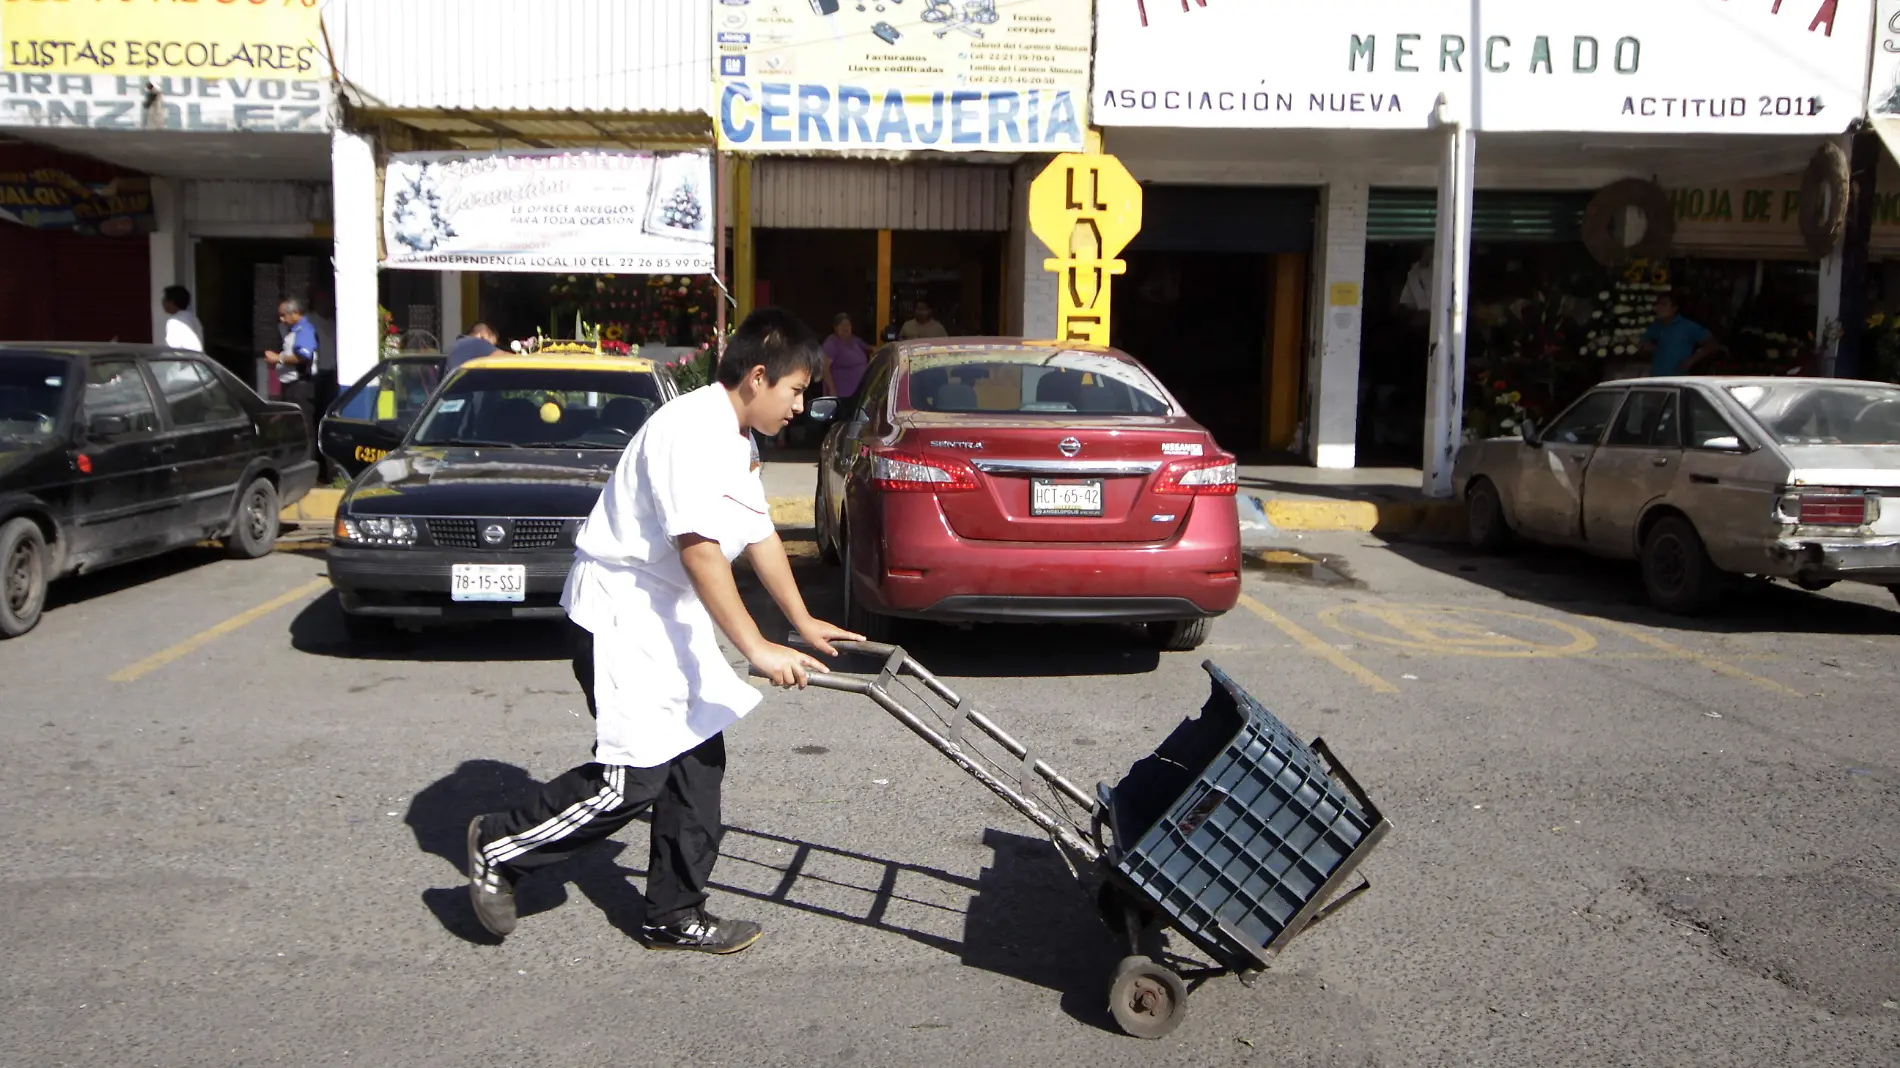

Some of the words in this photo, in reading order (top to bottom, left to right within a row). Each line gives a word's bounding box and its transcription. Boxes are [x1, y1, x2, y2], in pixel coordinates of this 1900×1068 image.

[10, 39, 116, 68] LISTAS
[126, 40, 314, 72] ESCOLARES
[865, 53, 928, 62] Facturamos
[1348, 33, 1640, 75] MERCADO
[848, 64, 880, 72] Llaves
[885, 65, 944, 73] codificadas
[116, 74, 320, 100] HUEVOS
[1104, 79, 1292, 112] ASOCIACIÓN
[1308, 93, 1402, 112] NUEVA
[1621, 96, 1746, 117] ACTITUD
[1759, 96, 1818, 116] 2011
[512, 205, 525, 214] LE
[528, 205, 570, 214] OFRECE
[574, 205, 636, 215] ARREGLOS
[1674, 187, 1733, 221] HOJA
[1742, 189, 1774, 222] DE
[511, 216, 541, 225] PARA
[544, 216, 578, 226] TODA
[424, 255, 526, 266] INDEPENDENCIA
[531, 256, 567, 267] LOCAL
[574, 257, 587, 267] 10
[620, 258, 634, 268] 22
[638, 258, 652, 268] 26
[657, 258, 671, 268] 85
[675, 258, 689, 268] 99
[930, 440, 984, 449] SENTRA
[1036, 488, 1099, 504] HCT-65-42
[455, 575, 522, 590] 78-15-SSJ
